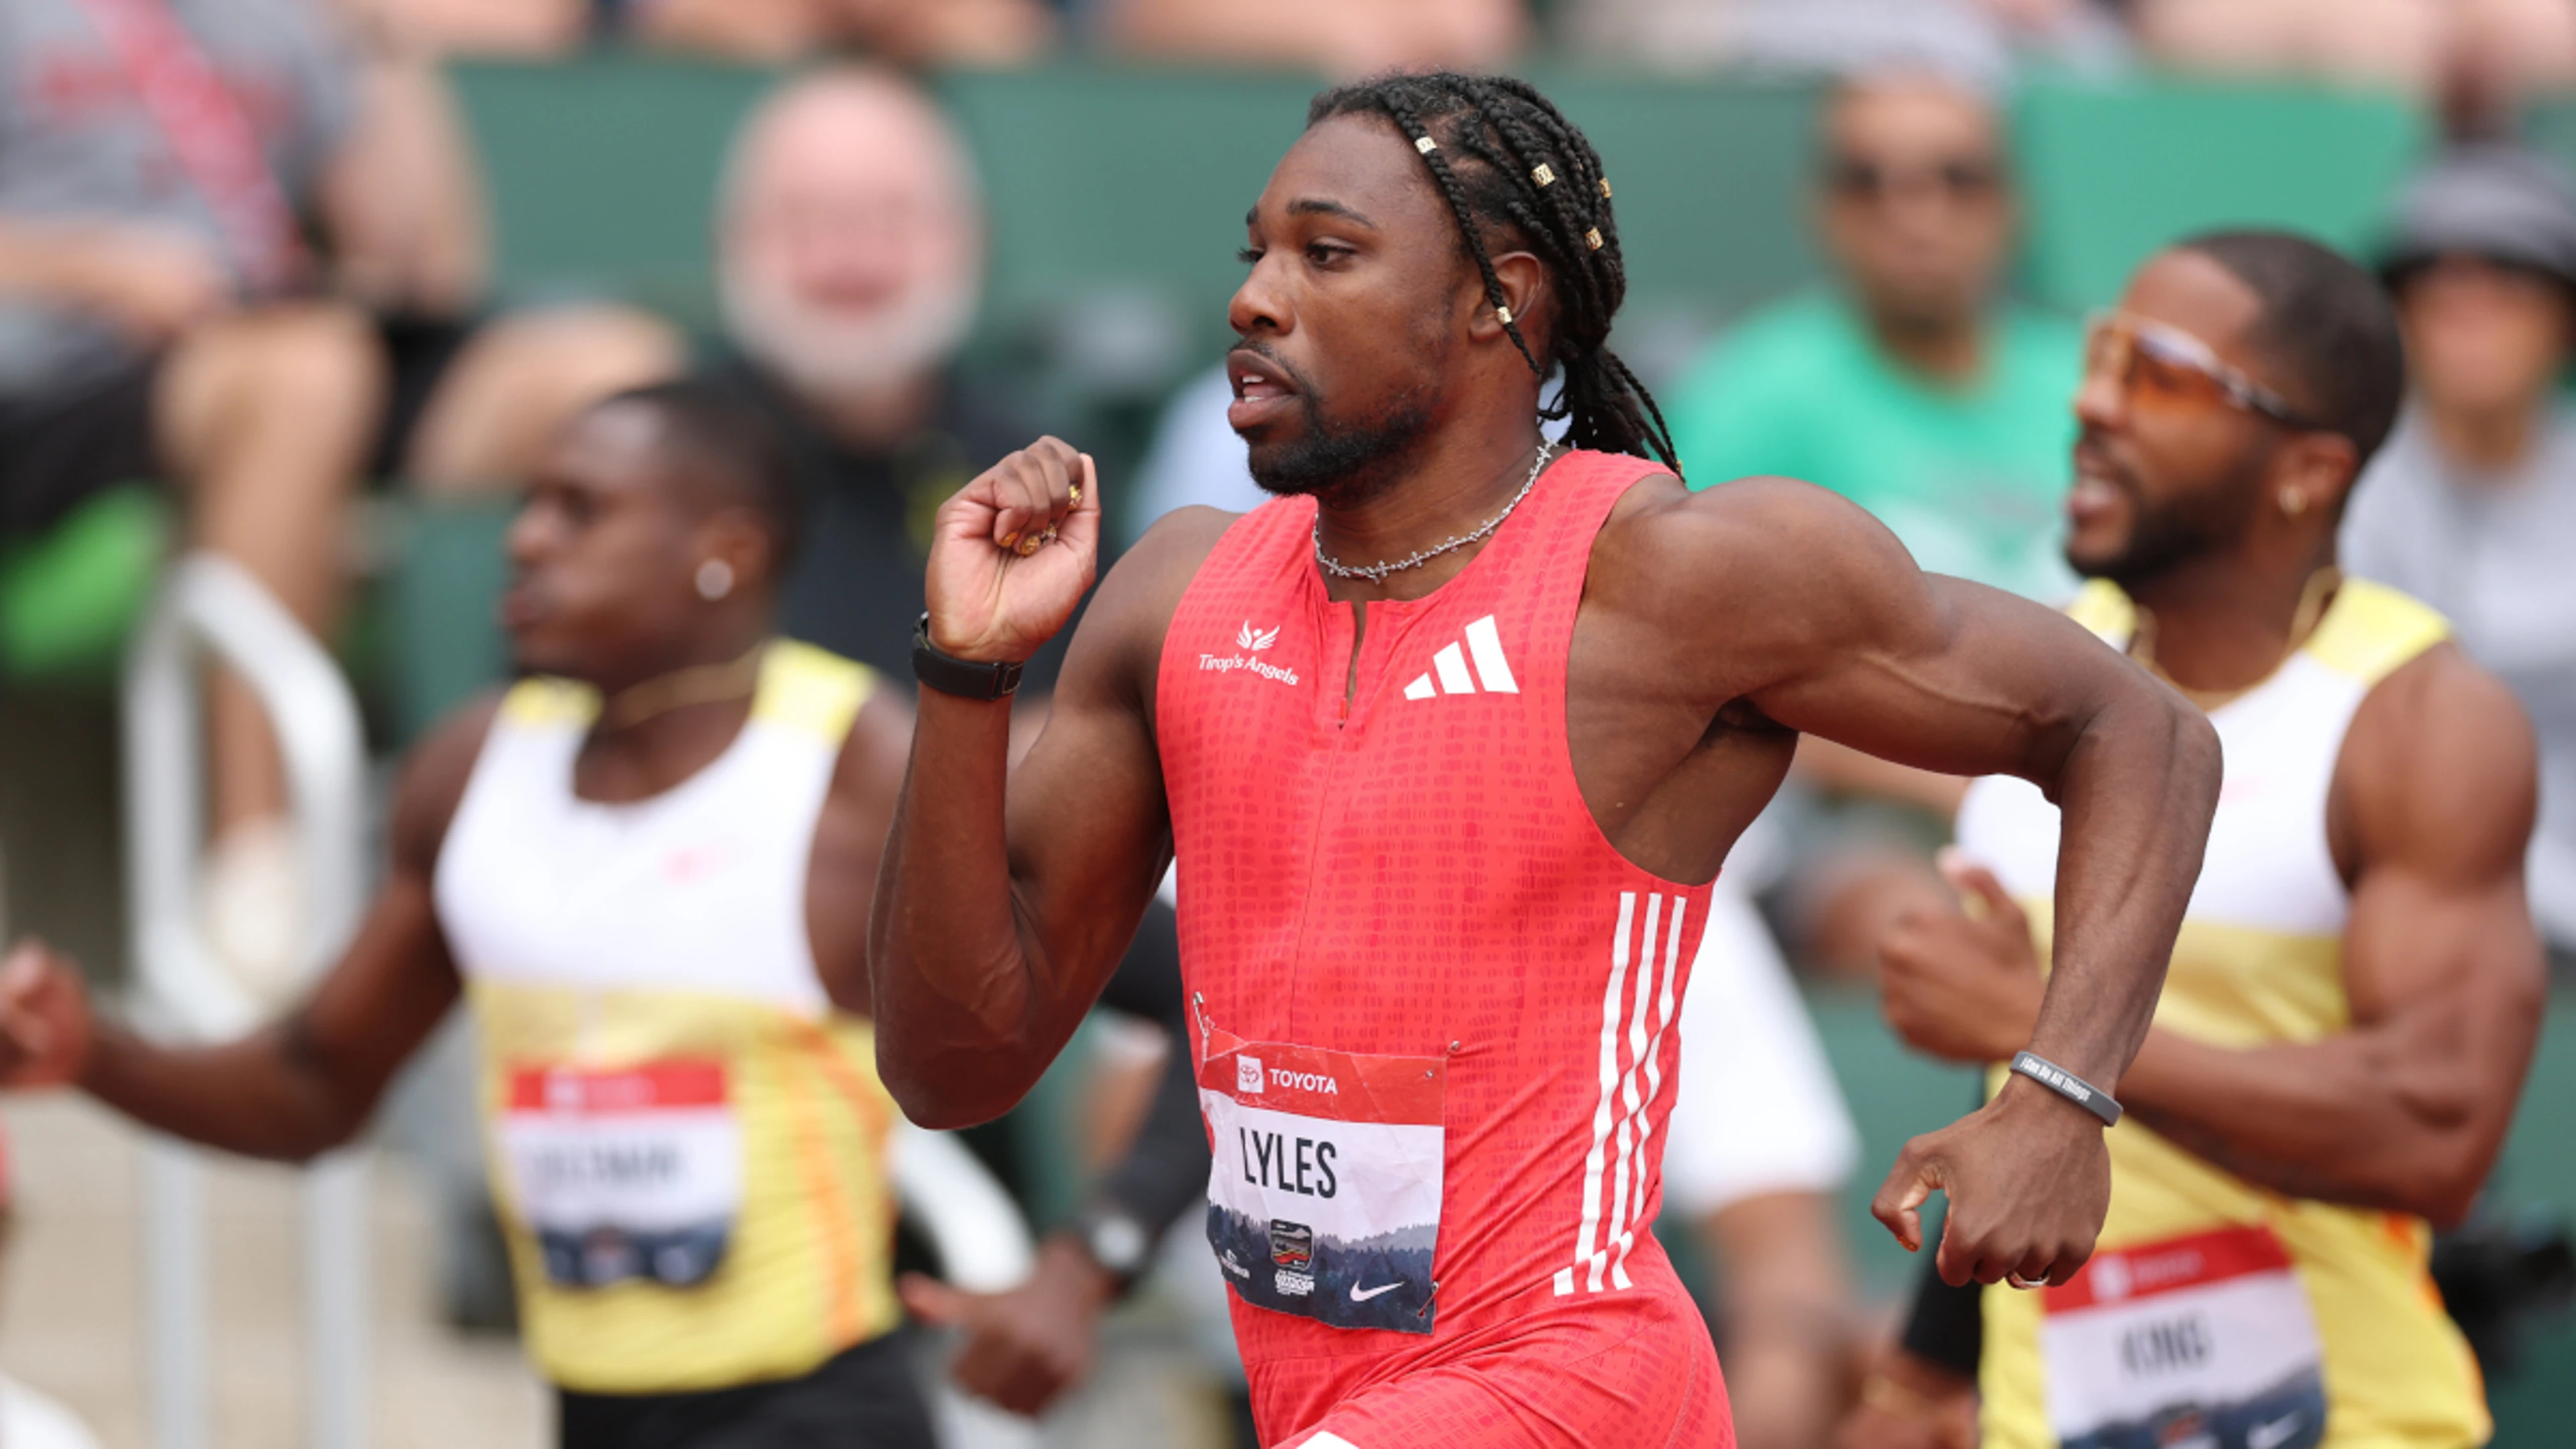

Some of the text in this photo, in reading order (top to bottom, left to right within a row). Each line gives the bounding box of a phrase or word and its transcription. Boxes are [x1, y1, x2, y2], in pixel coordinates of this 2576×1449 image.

[1199, 653, 1299, 686] Tirop's Angels
[1269, 1068, 1338, 1095] TOYOTA
[2062, 1077, 2092, 1102] Things
[1239, 1126, 1338, 1199] LYLES
